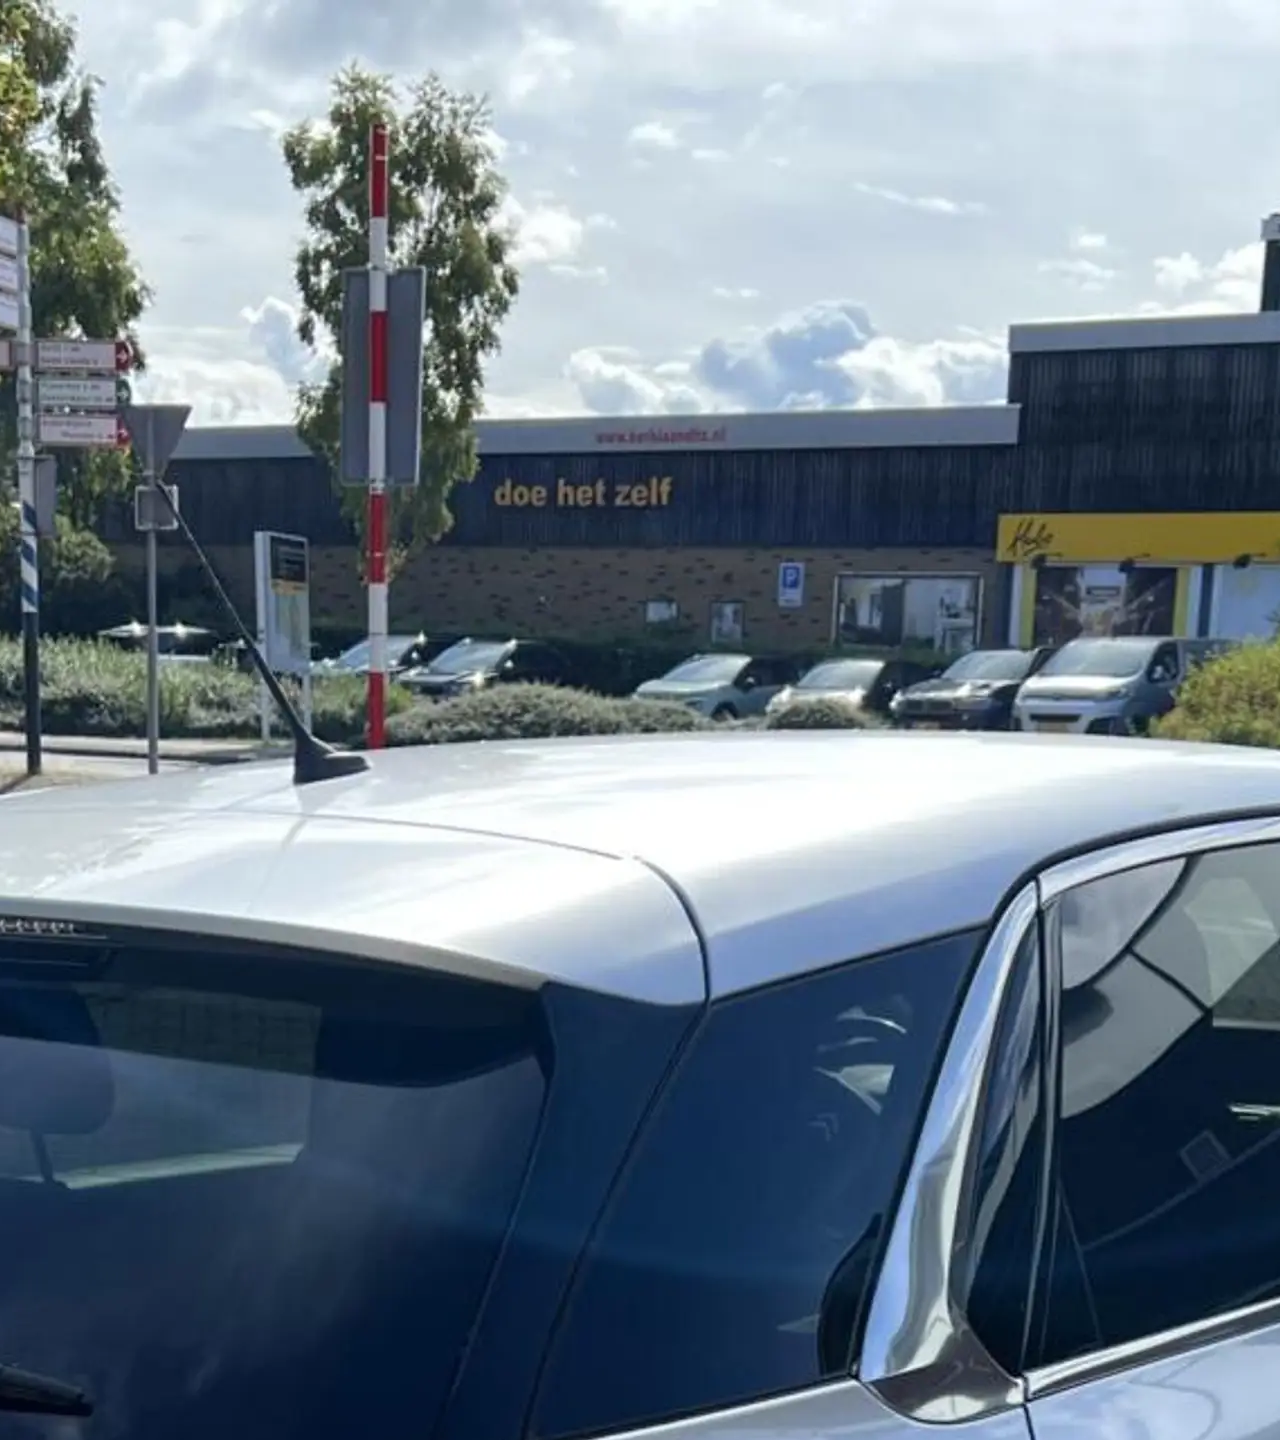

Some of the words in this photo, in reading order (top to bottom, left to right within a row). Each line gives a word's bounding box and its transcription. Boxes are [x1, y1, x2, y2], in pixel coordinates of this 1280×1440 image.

[494, 479, 548, 507] doe
[557, 478, 608, 507] het
[614, 476, 674, 507] zelf
